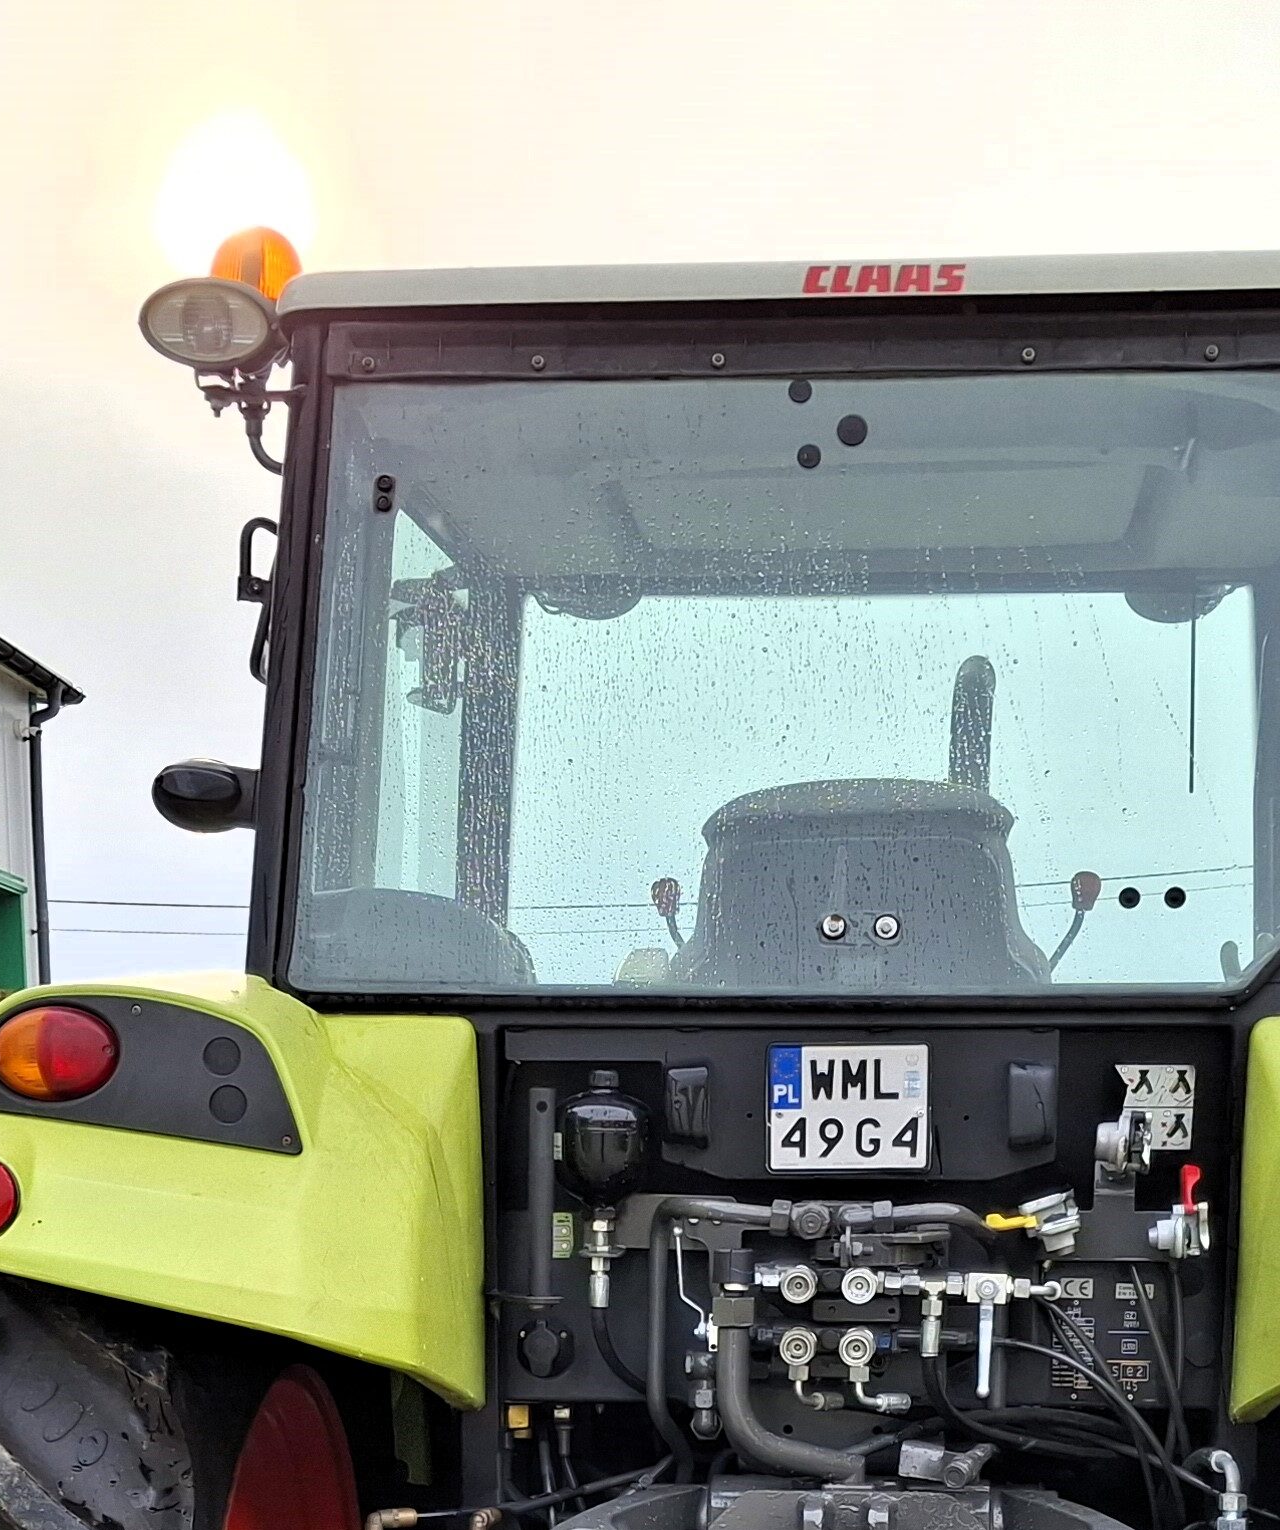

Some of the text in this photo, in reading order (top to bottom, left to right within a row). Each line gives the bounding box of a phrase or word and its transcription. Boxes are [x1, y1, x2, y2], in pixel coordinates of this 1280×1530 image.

[802, 263, 966, 293] CLAAS
[773, 1084, 800, 1104] PL
[810, 1059, 899, 1100] WML
[781, 1117, 919, 1158] 49G4
[1064, 1280, 1090, 1297] CE
